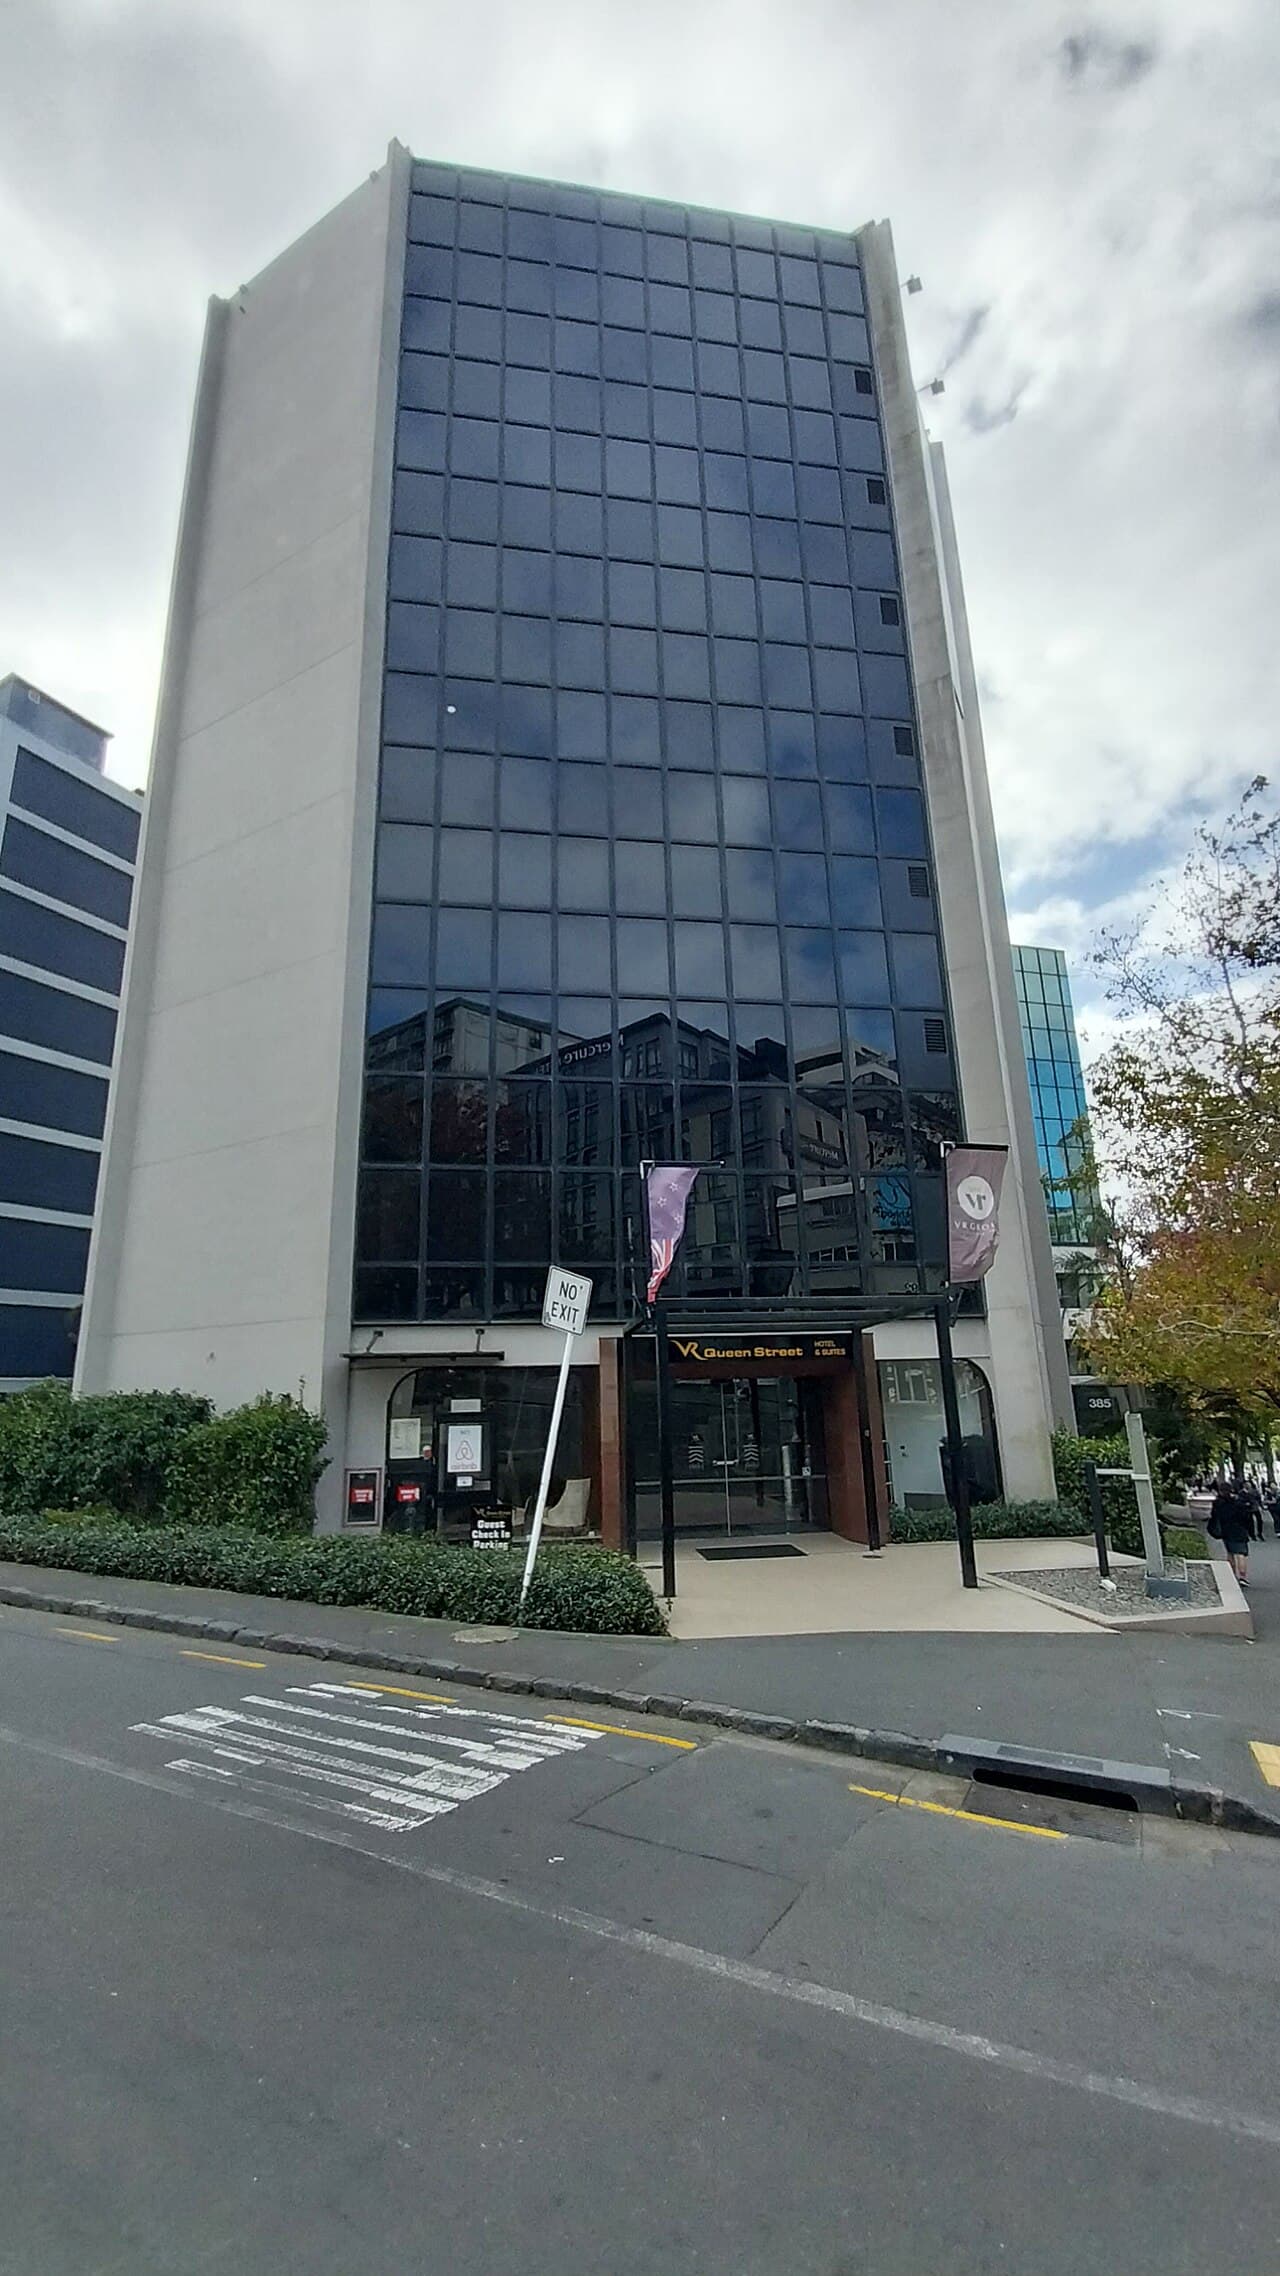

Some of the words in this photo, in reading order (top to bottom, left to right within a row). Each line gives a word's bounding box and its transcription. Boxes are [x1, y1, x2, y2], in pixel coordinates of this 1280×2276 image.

[559, 1280, 578, 1301] NO
[551, 1300, 580, 1324] EXIT
[670, 1339, 708, 1361] VR
[704, 1347, 751, 1358] Queen
[753, 1347, 803, 1358] Street
[822, 1347, 846, 1356] SUITES
[1088, 1398, 1112, 1408] 385
[477, 1519, 506, 1529] Guest
[471, 1529, 500, 1539] Check
[473, 1540, 509, 1551] Parking
